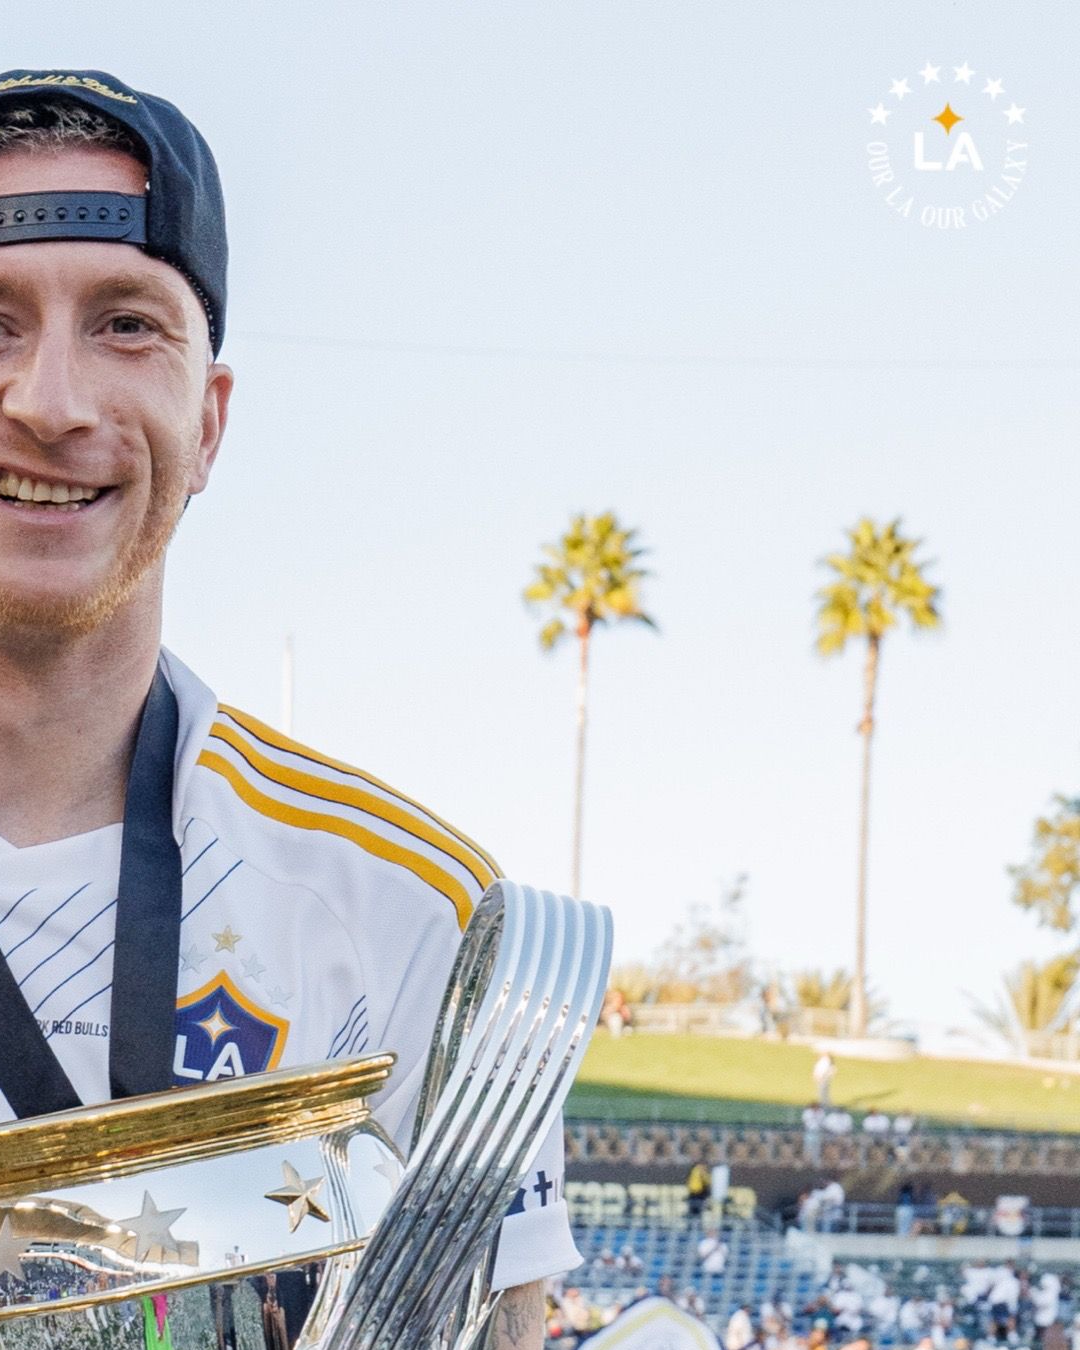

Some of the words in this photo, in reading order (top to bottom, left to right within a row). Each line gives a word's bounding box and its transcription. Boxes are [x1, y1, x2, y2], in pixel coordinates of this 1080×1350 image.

[51, 1020, 73, 1035] RED
[74, 1021, 109, 1037] BULLS
[173, 1034, 246, 1081] LA
